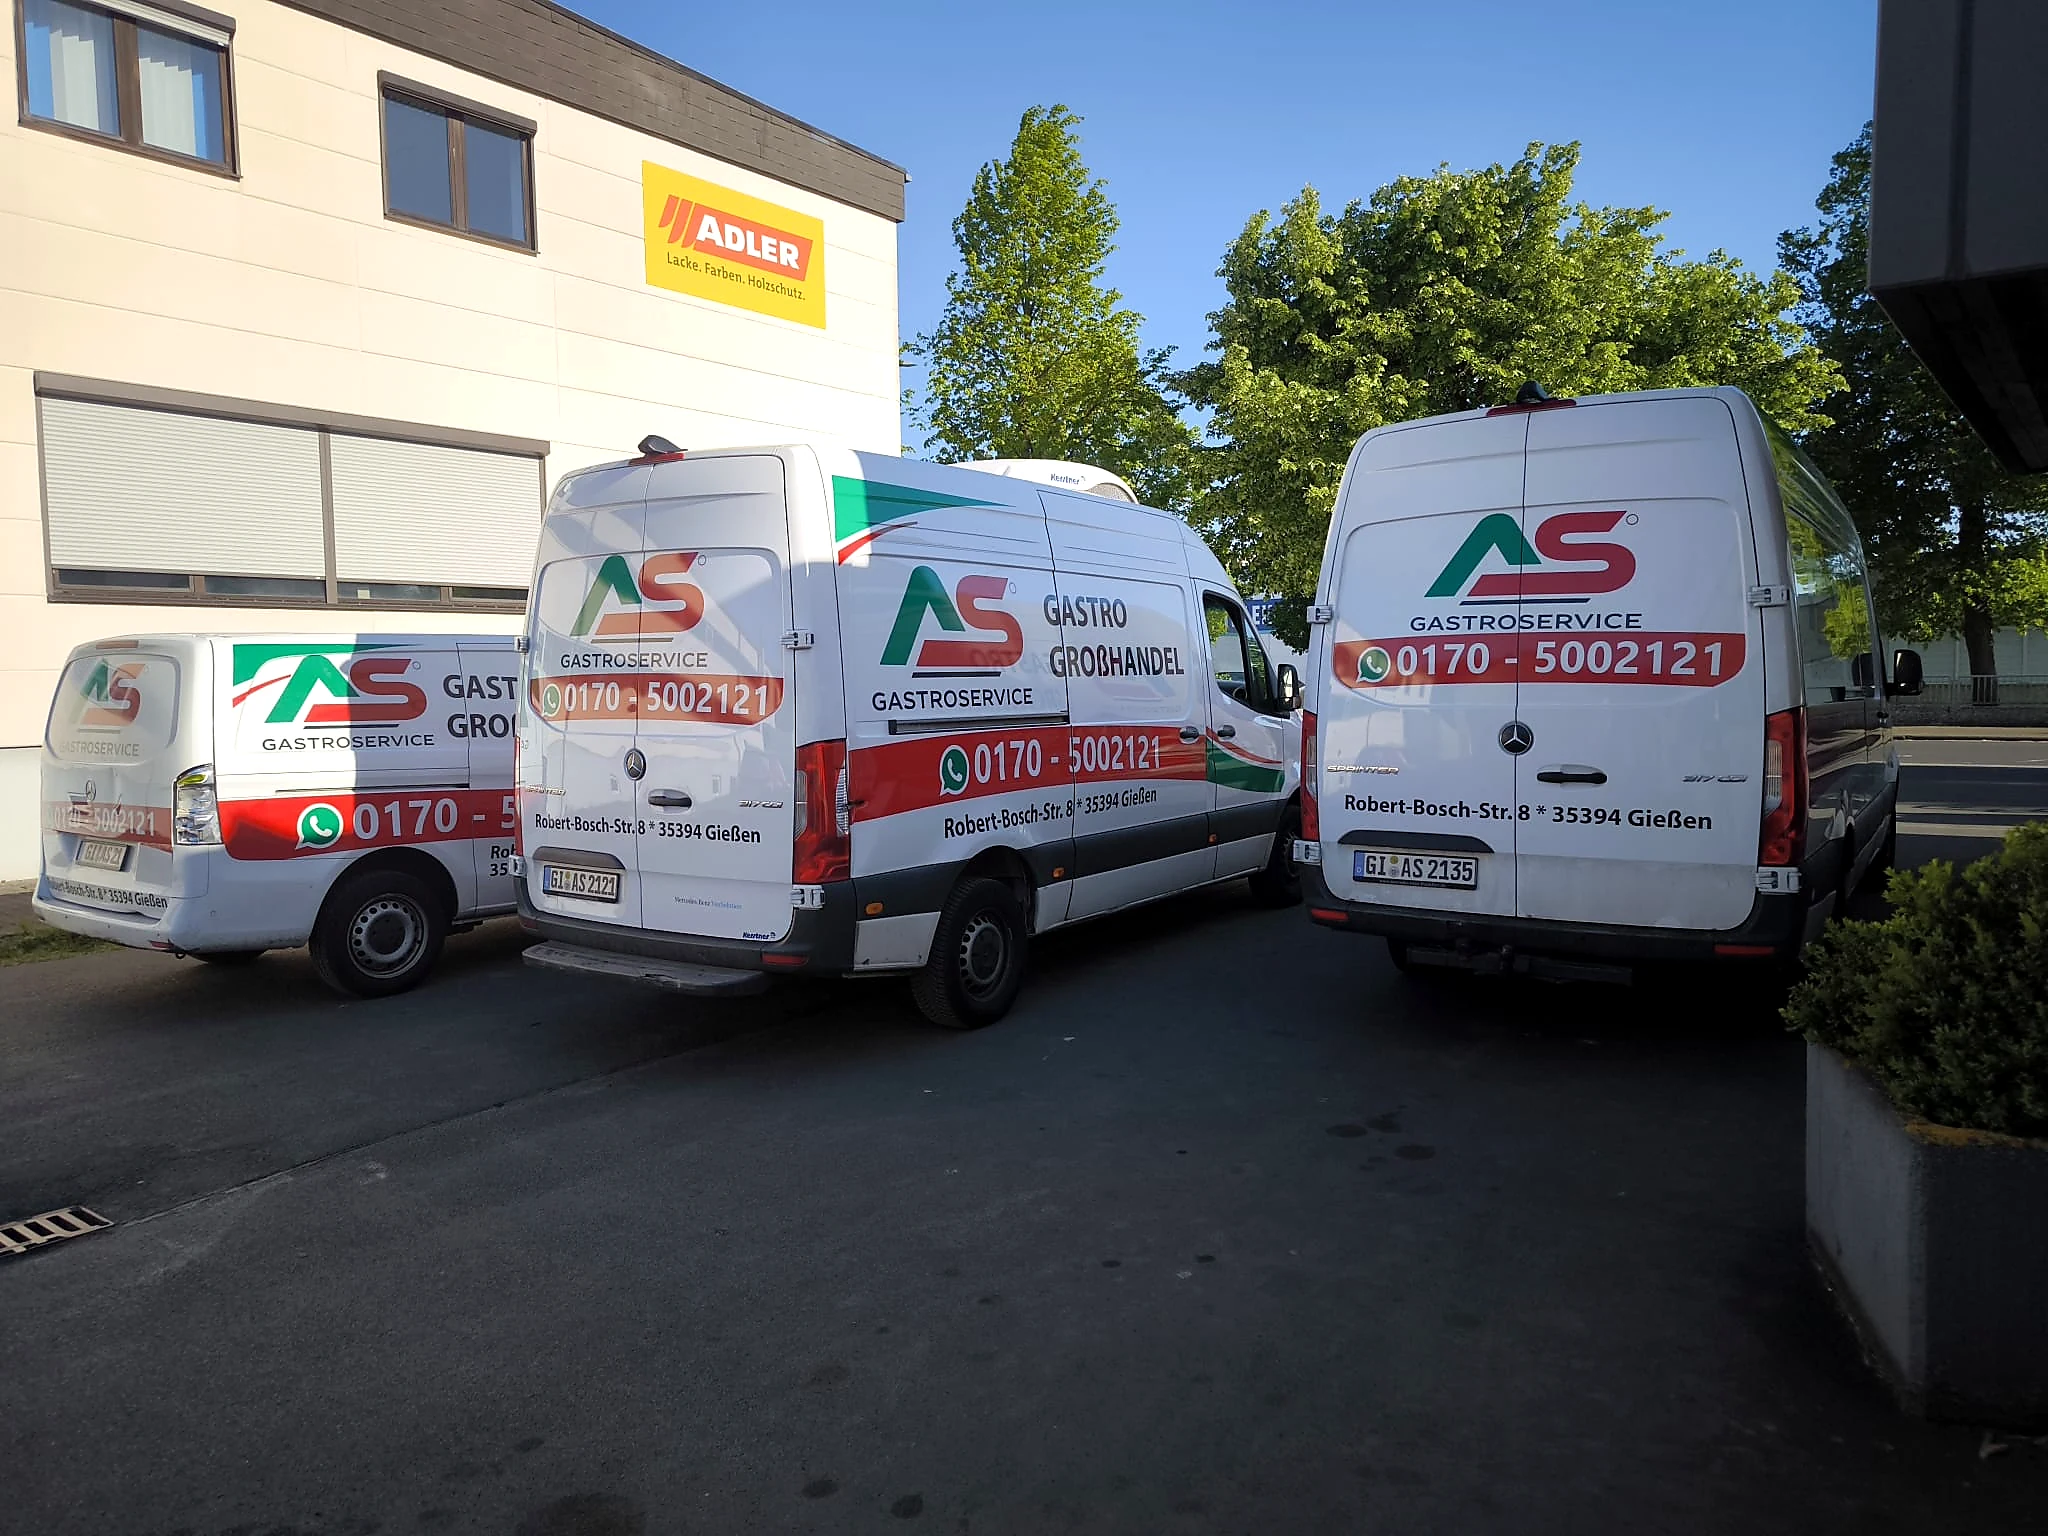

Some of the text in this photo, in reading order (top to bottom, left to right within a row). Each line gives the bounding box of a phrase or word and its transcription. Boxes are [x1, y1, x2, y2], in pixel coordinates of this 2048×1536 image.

[696, 214, 800, 270] ADLER
[667, 252, 806, 300] Lacke. Farben. Holzschutz.
[1423, 510, 1637, 597] AS
[569, 552, 705, 636] AS
[1043, 594, 1127, 628] GASTRO
[879, 565, 1024, 667] AS
[1410, 613, 1643, 632] GASTROSERVICE
[560, 652, 708, 669] GASTROSERVICE
[1049, 644, 1185, 678] GROßHANDEL
[1396, 642, 1490, 676] 0170
[1534, 641, 1722, 676] 5002121
[265, 655, 427, 723] AS
[564, 682, 621, 711] 0170
[647, 682, 768, 716] 5002121
[872, 688, 1033, 711] GASTROSERVICE
[262, 734, 435, 751] GASTROSERVICE
[447, 713, 516, 738] GRO
[973, 739, 1042, 783] 0170
[1069, 735, 1161, 774] 5002121
[353, 798, 458, 840] 0170
[535, 813, 761, 843] Robert-Bosch-Str. 8 35394 Gießen
[944, 788, 1157, 838] Robert-Bosch-Str. 8 35394 Gießen
[1345, 795, 1712, 830] Robert-Bosch-Str. 8 35394 Gießen
[551, 870, 616, 896] GI AS 2121
[1366, 855, 1473, 881] GI AS 2135
[109, 889, 133, 904] 35394
[134, 893, 168, 909] Gießen
